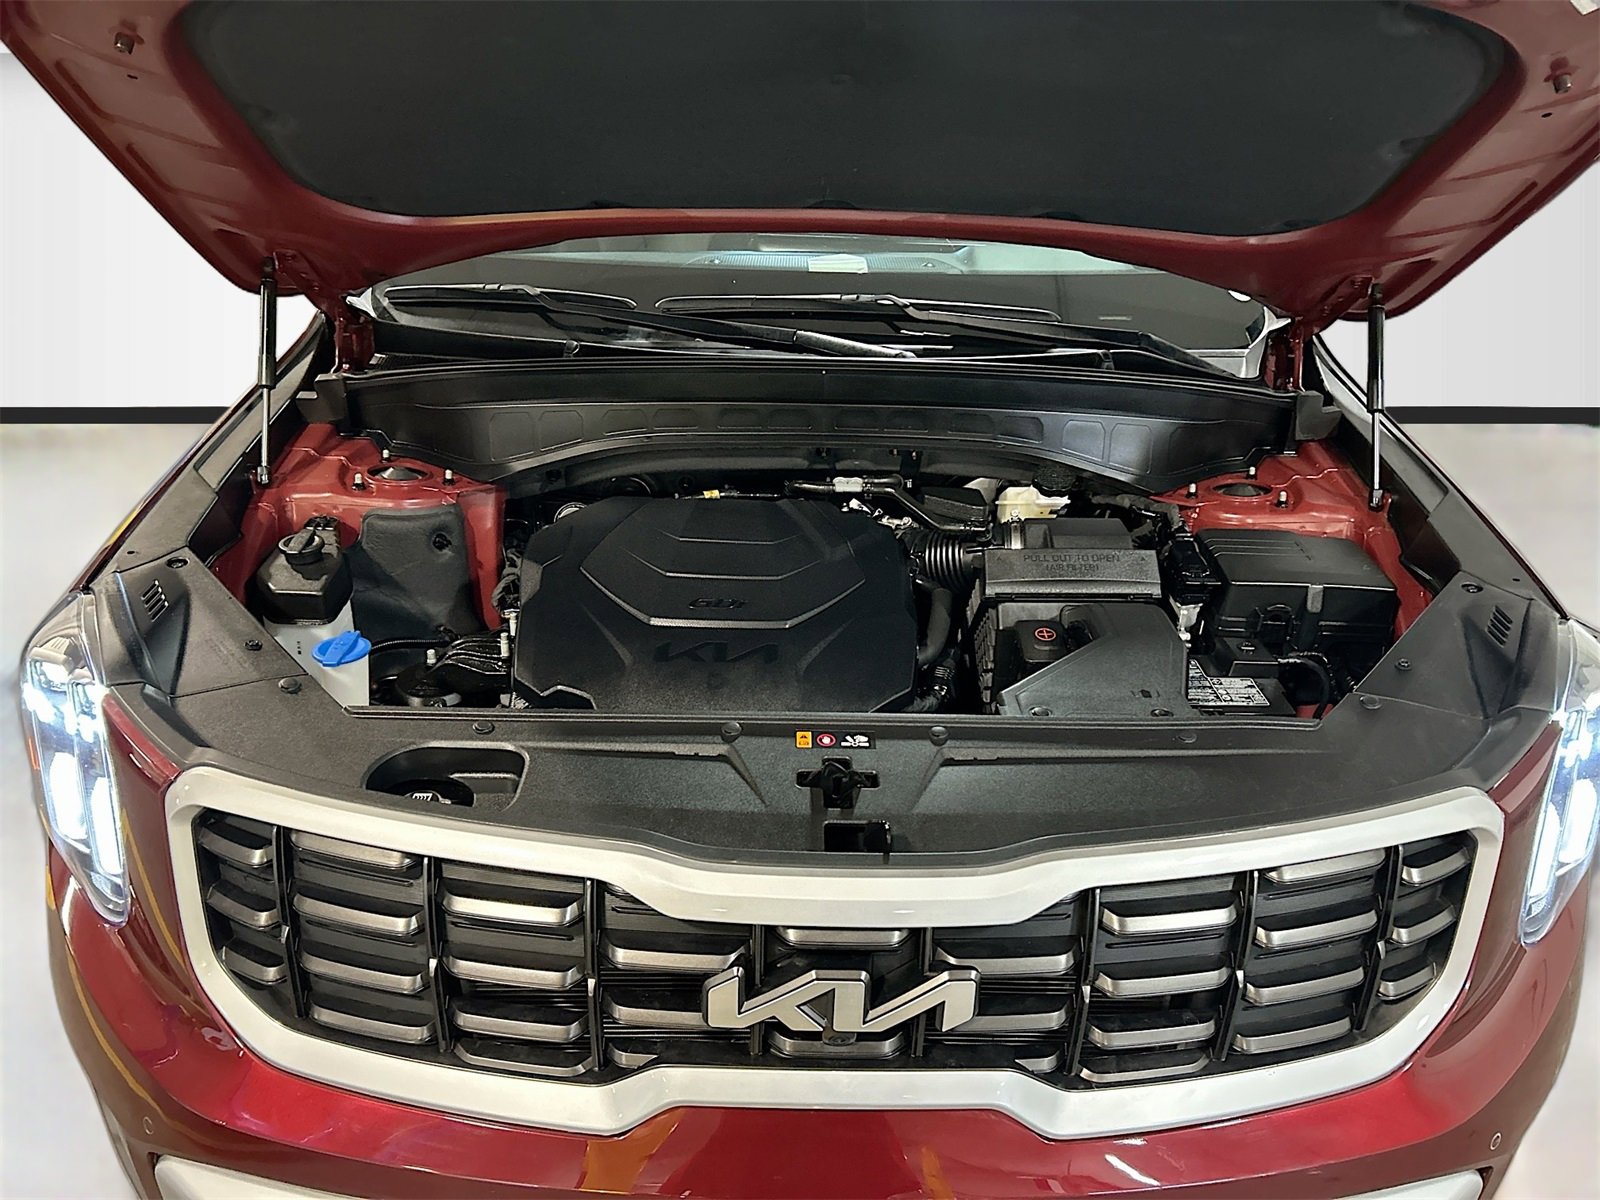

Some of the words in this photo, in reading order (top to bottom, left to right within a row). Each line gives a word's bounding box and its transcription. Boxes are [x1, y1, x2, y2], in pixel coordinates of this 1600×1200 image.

[1023, 554, 1049, 562] PULL
[1052, 554, 1071, 562] OUT
[1075, 554, 1089, 562] TO
[1092, 554, 1120, 563] OPEN
[653, 640, 779, 664] KIA
[702, 966, 981, 1033] KIA
